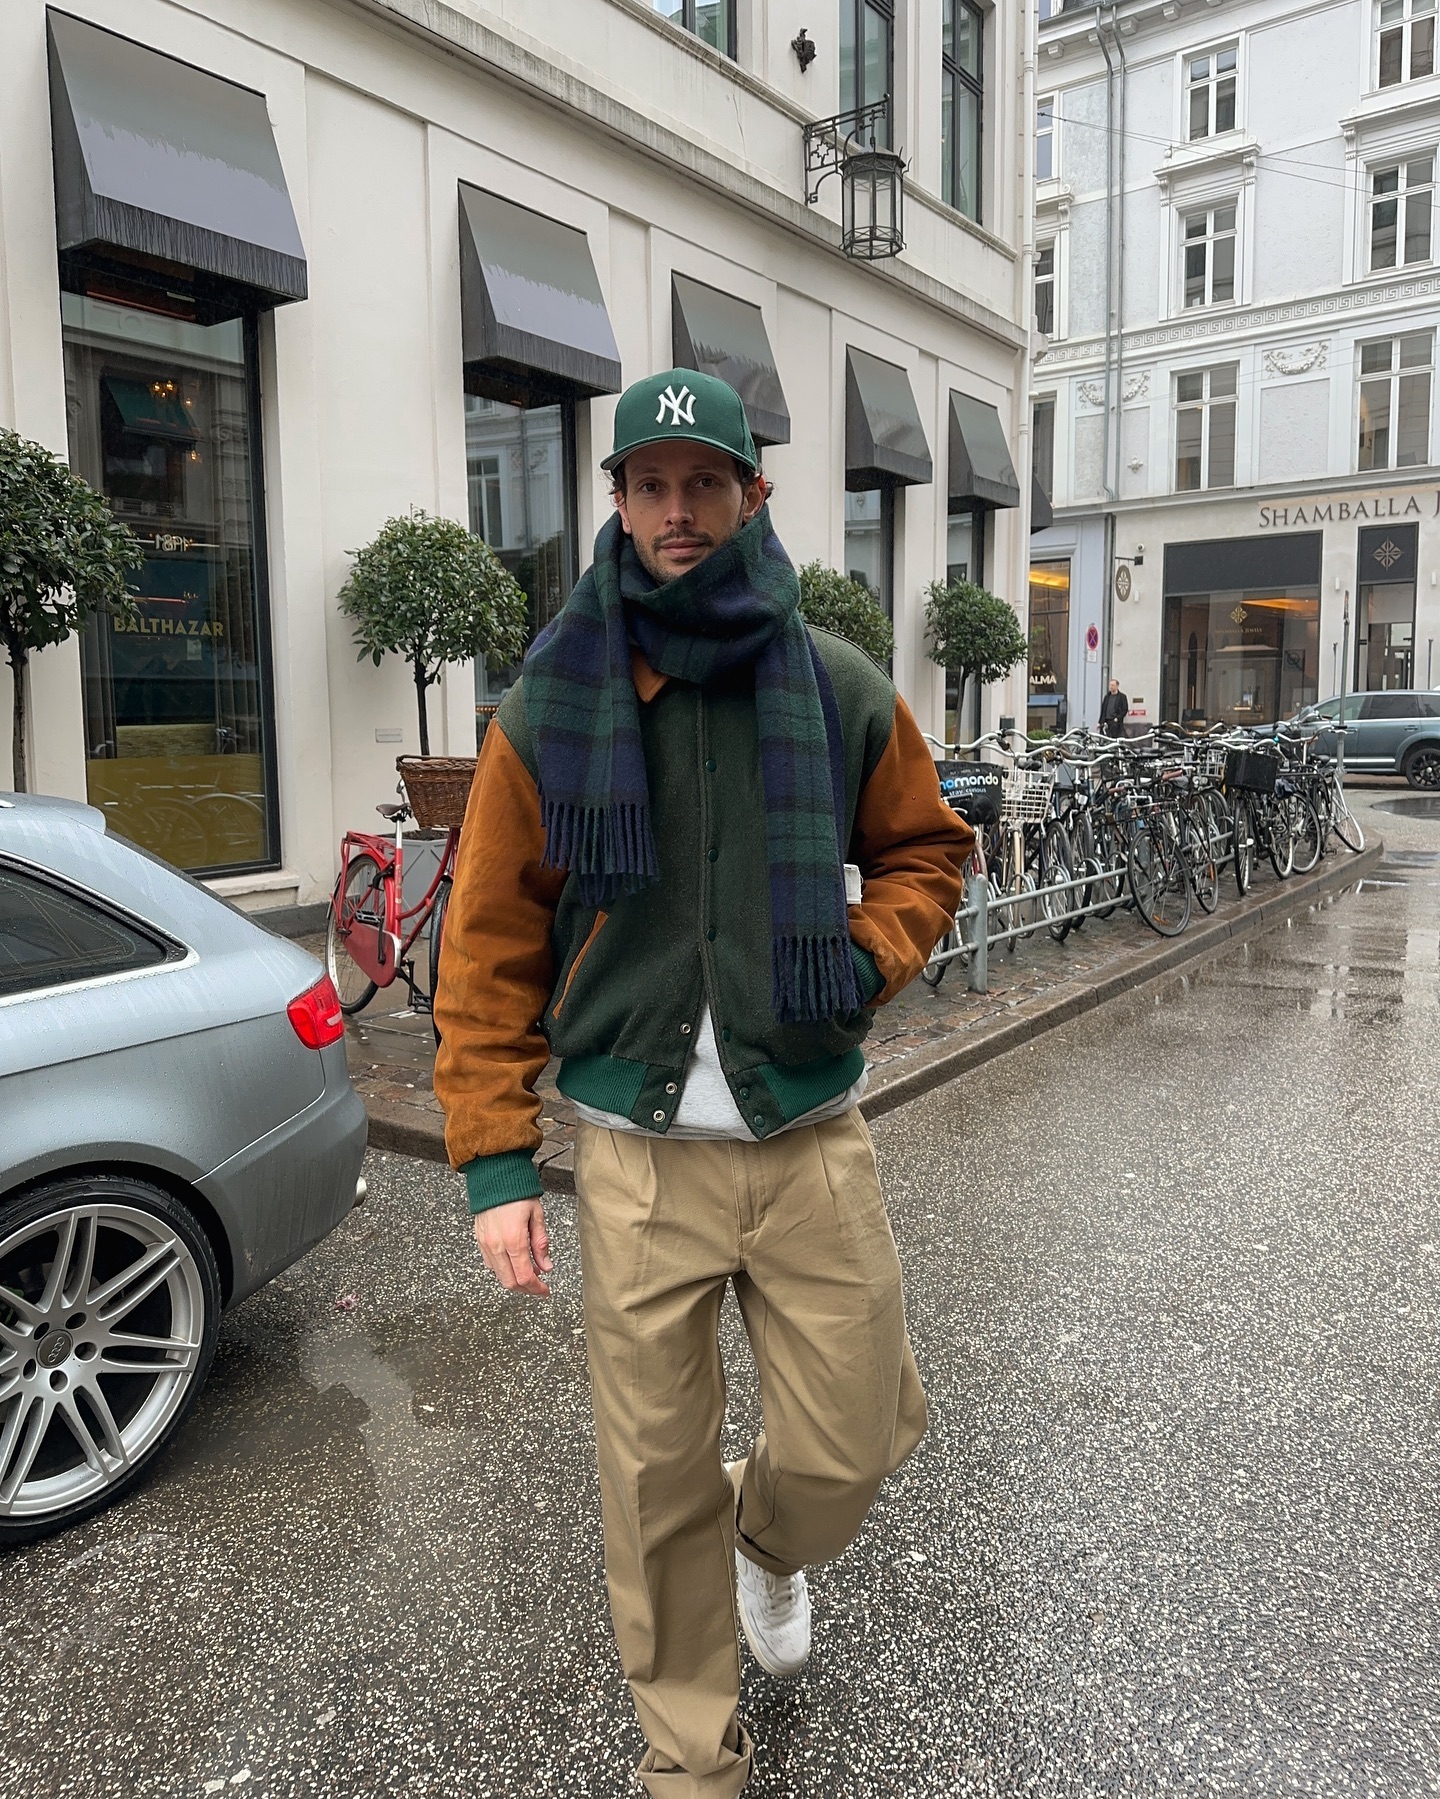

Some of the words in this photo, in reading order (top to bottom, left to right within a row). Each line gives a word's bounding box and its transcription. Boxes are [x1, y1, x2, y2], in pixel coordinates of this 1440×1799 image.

[656, 385, 696, 426] NY
[1259, 495, 1421, 528] SHAMBALLA
[114, 616, 224, 636] BALTHAZAR
[1029, 675, 1057, 685] ALMA
